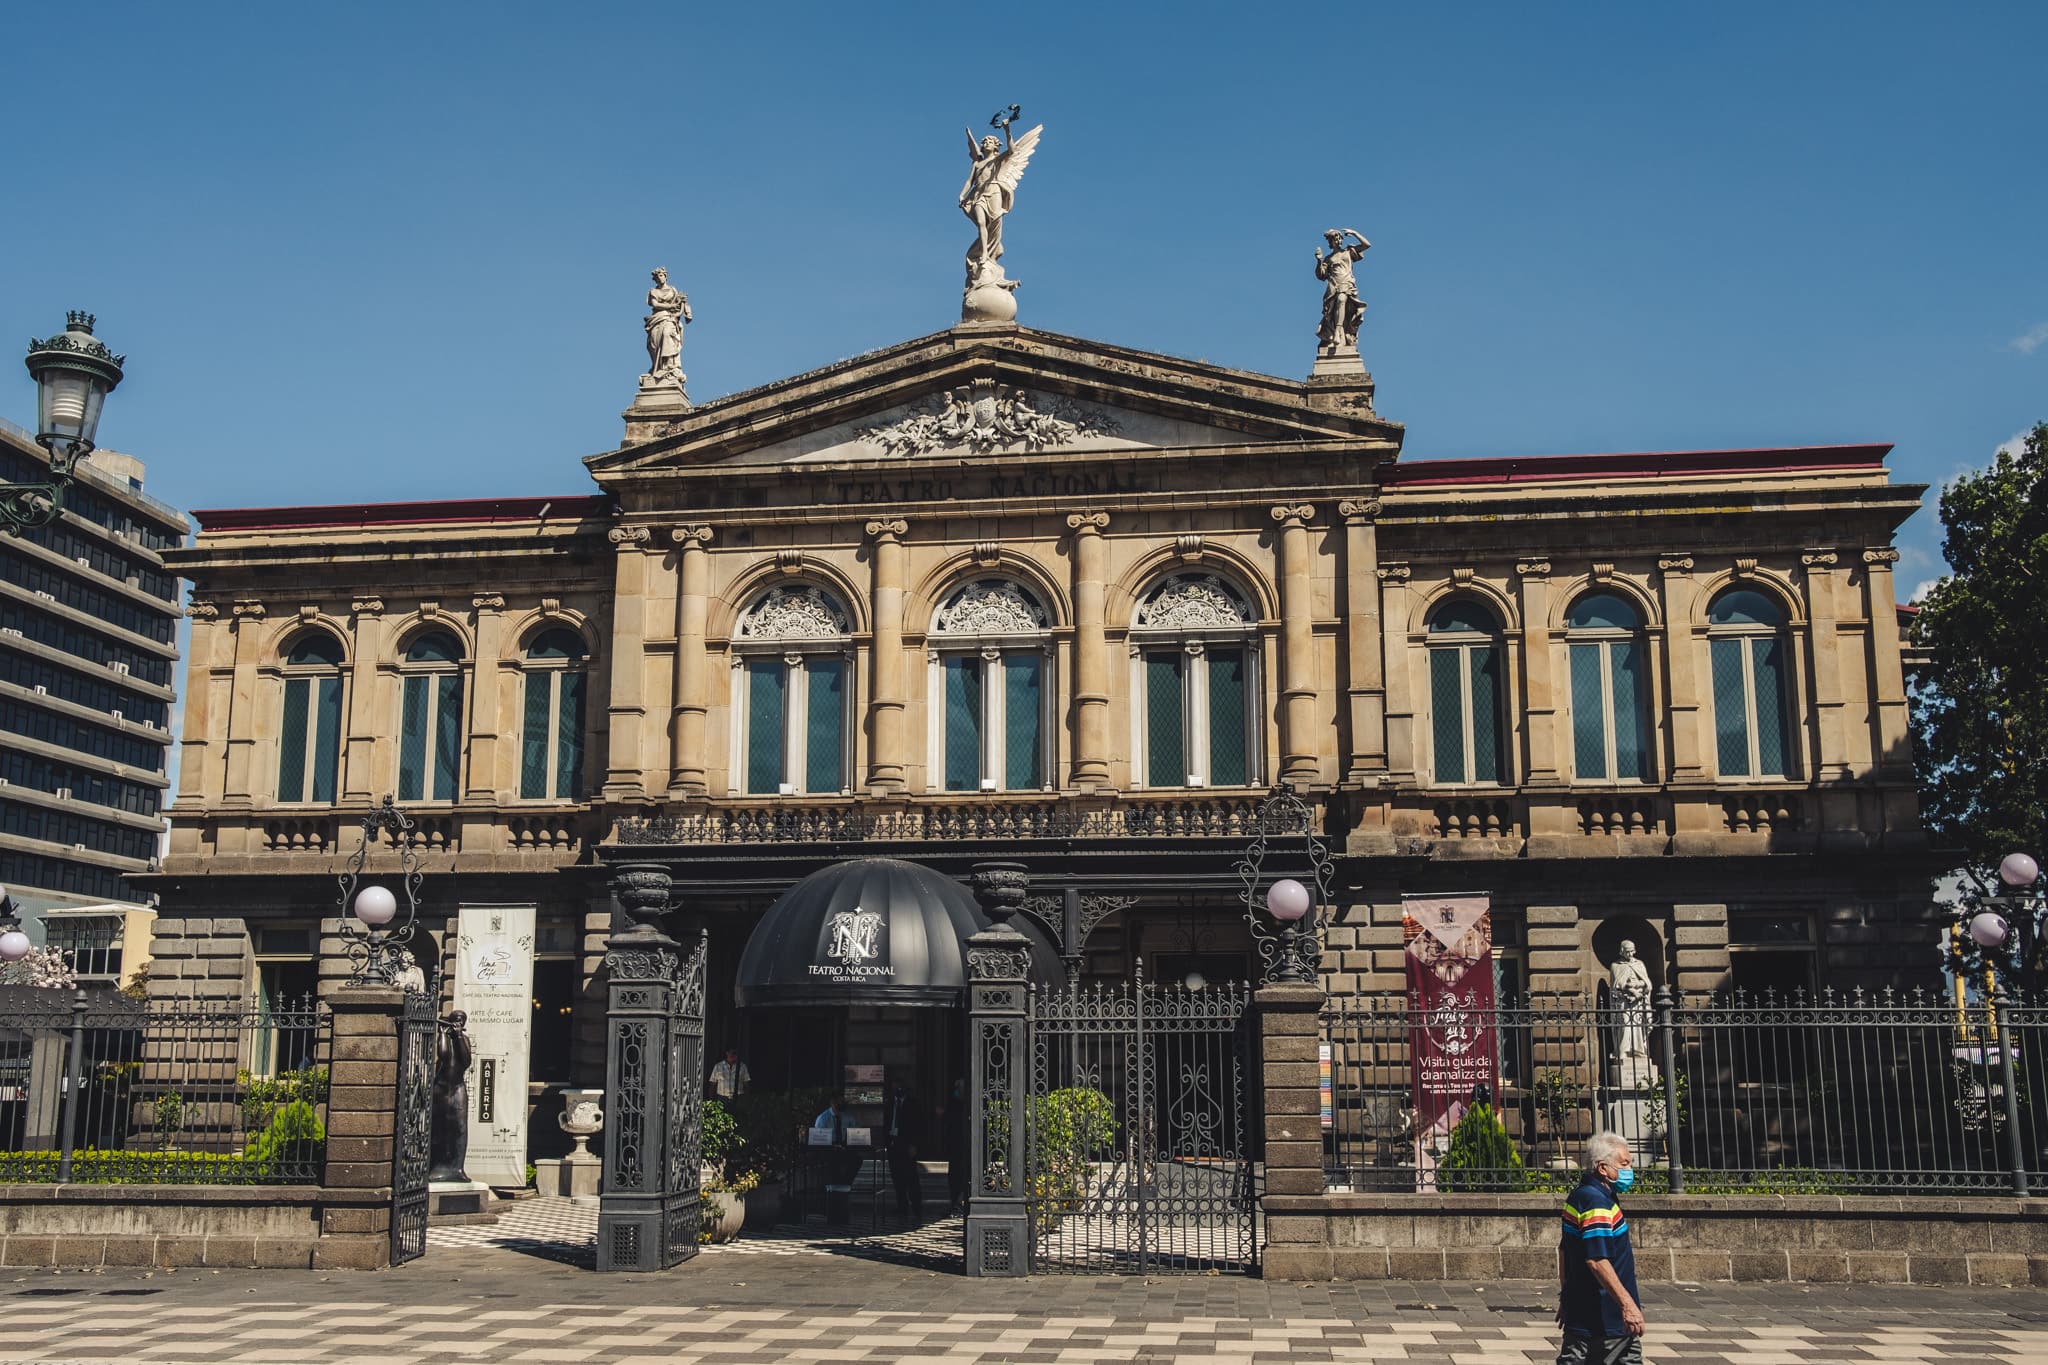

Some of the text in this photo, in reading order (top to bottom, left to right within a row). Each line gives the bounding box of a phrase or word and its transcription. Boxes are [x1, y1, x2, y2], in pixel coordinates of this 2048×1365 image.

[838, 472, 1142, 503] TEATRO NACIONAL
[808, 965, 896, 976] TEATRO NACIONAL
[1419, 1055, 1492, 1069] Visita guiada
[482, 1061, 491, 1120] ABIERTO
